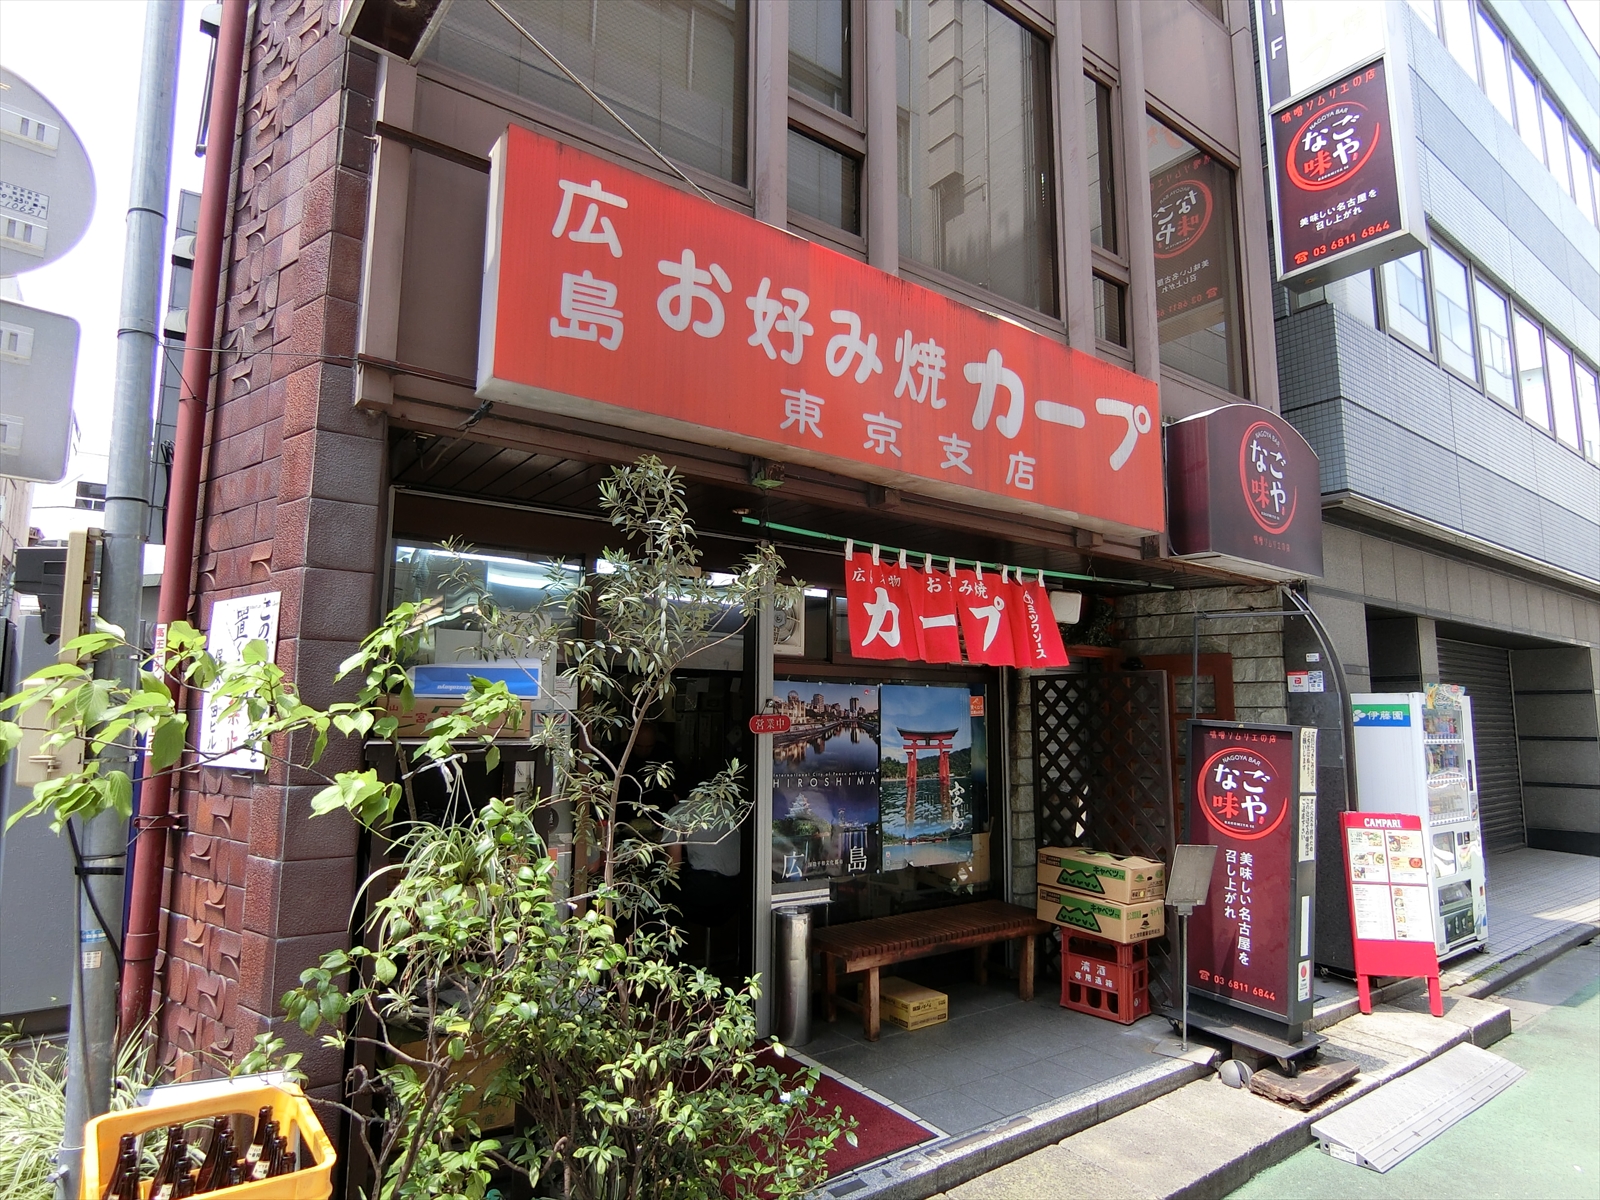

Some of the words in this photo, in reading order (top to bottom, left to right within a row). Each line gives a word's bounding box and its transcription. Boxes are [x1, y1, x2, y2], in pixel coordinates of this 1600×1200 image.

[1309, 112, 1335, 130] NAGOYA
[1335, 107, 1349, 116] BAR
[1299, 189, 1377, 228] 美味しい名古屋を
[1315, 206, 1363, 231] 召し上がれ
[1313, 245, 1327, 257] 03
[1330, 233, 1356, 250] 6811
[1361, 220, 1390, 239] 6844
[550, 179, 628, 351] 広島
[656, 248, 947, 410] お好み焼
[963, 348, 1152, 471] カープ
[780, 388, 1037, 491] 東京支店
[1255, 430, 1271, 439] NAGOYA
[1271, 434, 1280, 447] BAR
[862, 586, 1005, 652] カープ
[755, 717, 785, 730] 営業中
[1367, 710, 1403, 721] 伊藤園
[1209, 730, 1277, 744] 味噌ソムリエの店
[1222, 754, 1247, 763] NAGOYA
[1248, 757, 1261, 767] BAR
[772, 776, 876, 789] HIROSHIMA
[1364, 817, 1402, 828] CAMPARI
[1093, 866, 1119, 878] キャベツ
[1224, 849, 1237, 919] 召し上がれ
[1091, 903, 1115, 917] キャベツ
[1238, 851, 1253, 966] 美味しい名古屋を
[1080, 960, 1106, 976] 清酒
[1214, 974, 1225, 985] 03
[1228, 980, 1248, 993] 6811
[1252, 982, 1276, 1001] 6844
